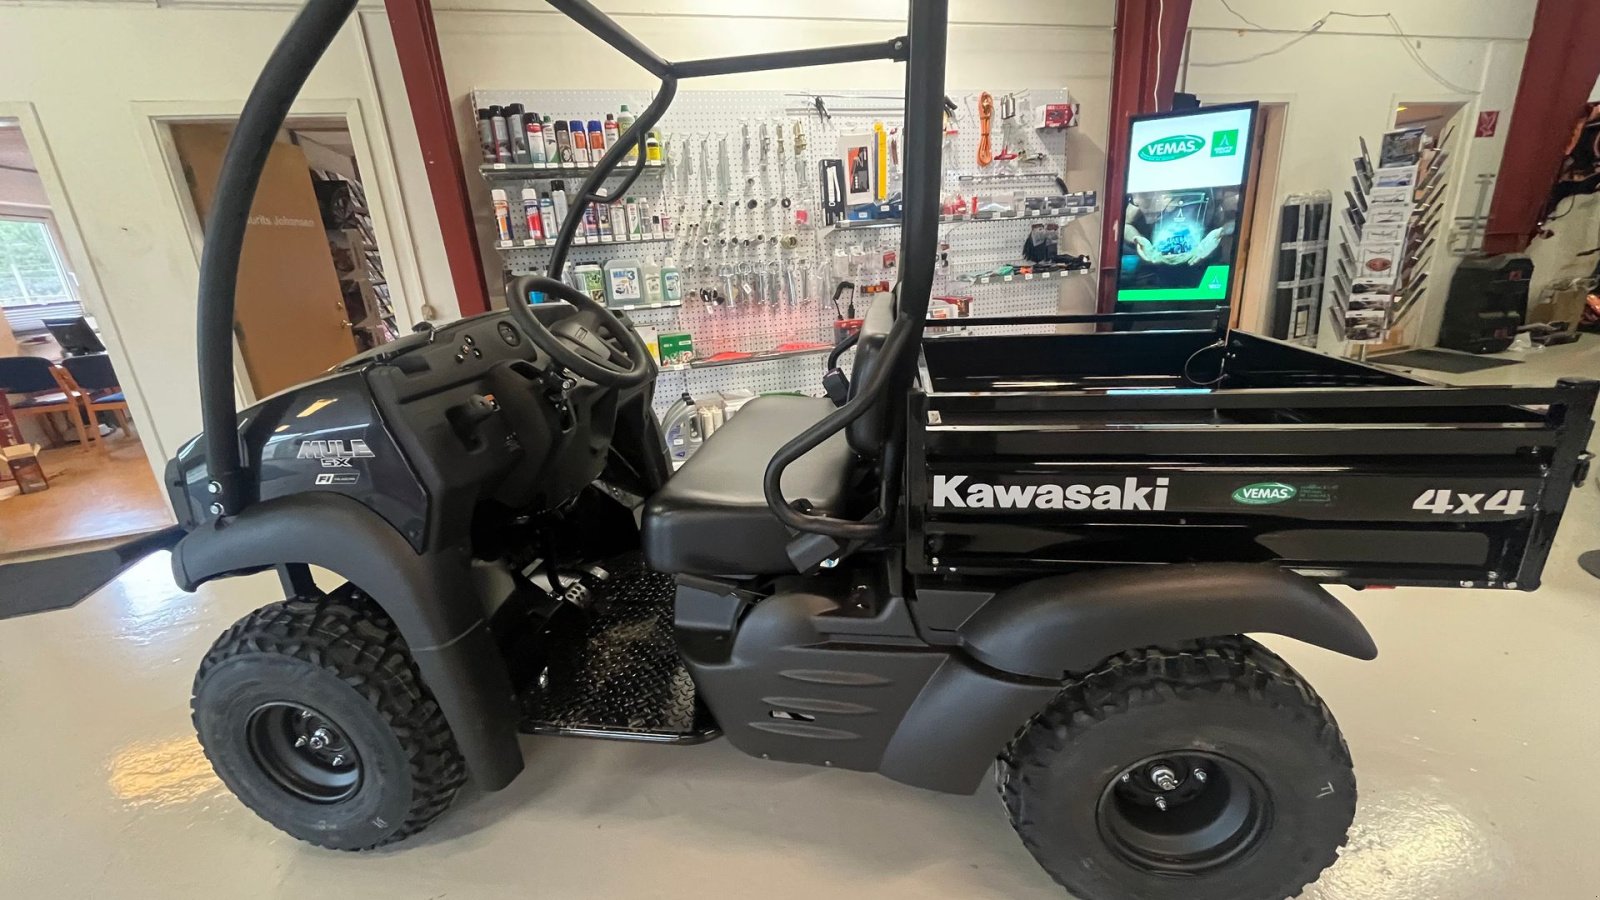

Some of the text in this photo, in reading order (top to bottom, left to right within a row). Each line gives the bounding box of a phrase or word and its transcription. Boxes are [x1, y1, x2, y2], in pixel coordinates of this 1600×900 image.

[1148, 140, 1196, 155] VEMAS
[297, 439, 376, 458] MULE
[320, 457, 352, 468] SX
[932, 475, 1170, 511] Kawasaki
[1243, 488, 1289, 499] VEMAS
[1412, 489, 1526, 515] 4x4
